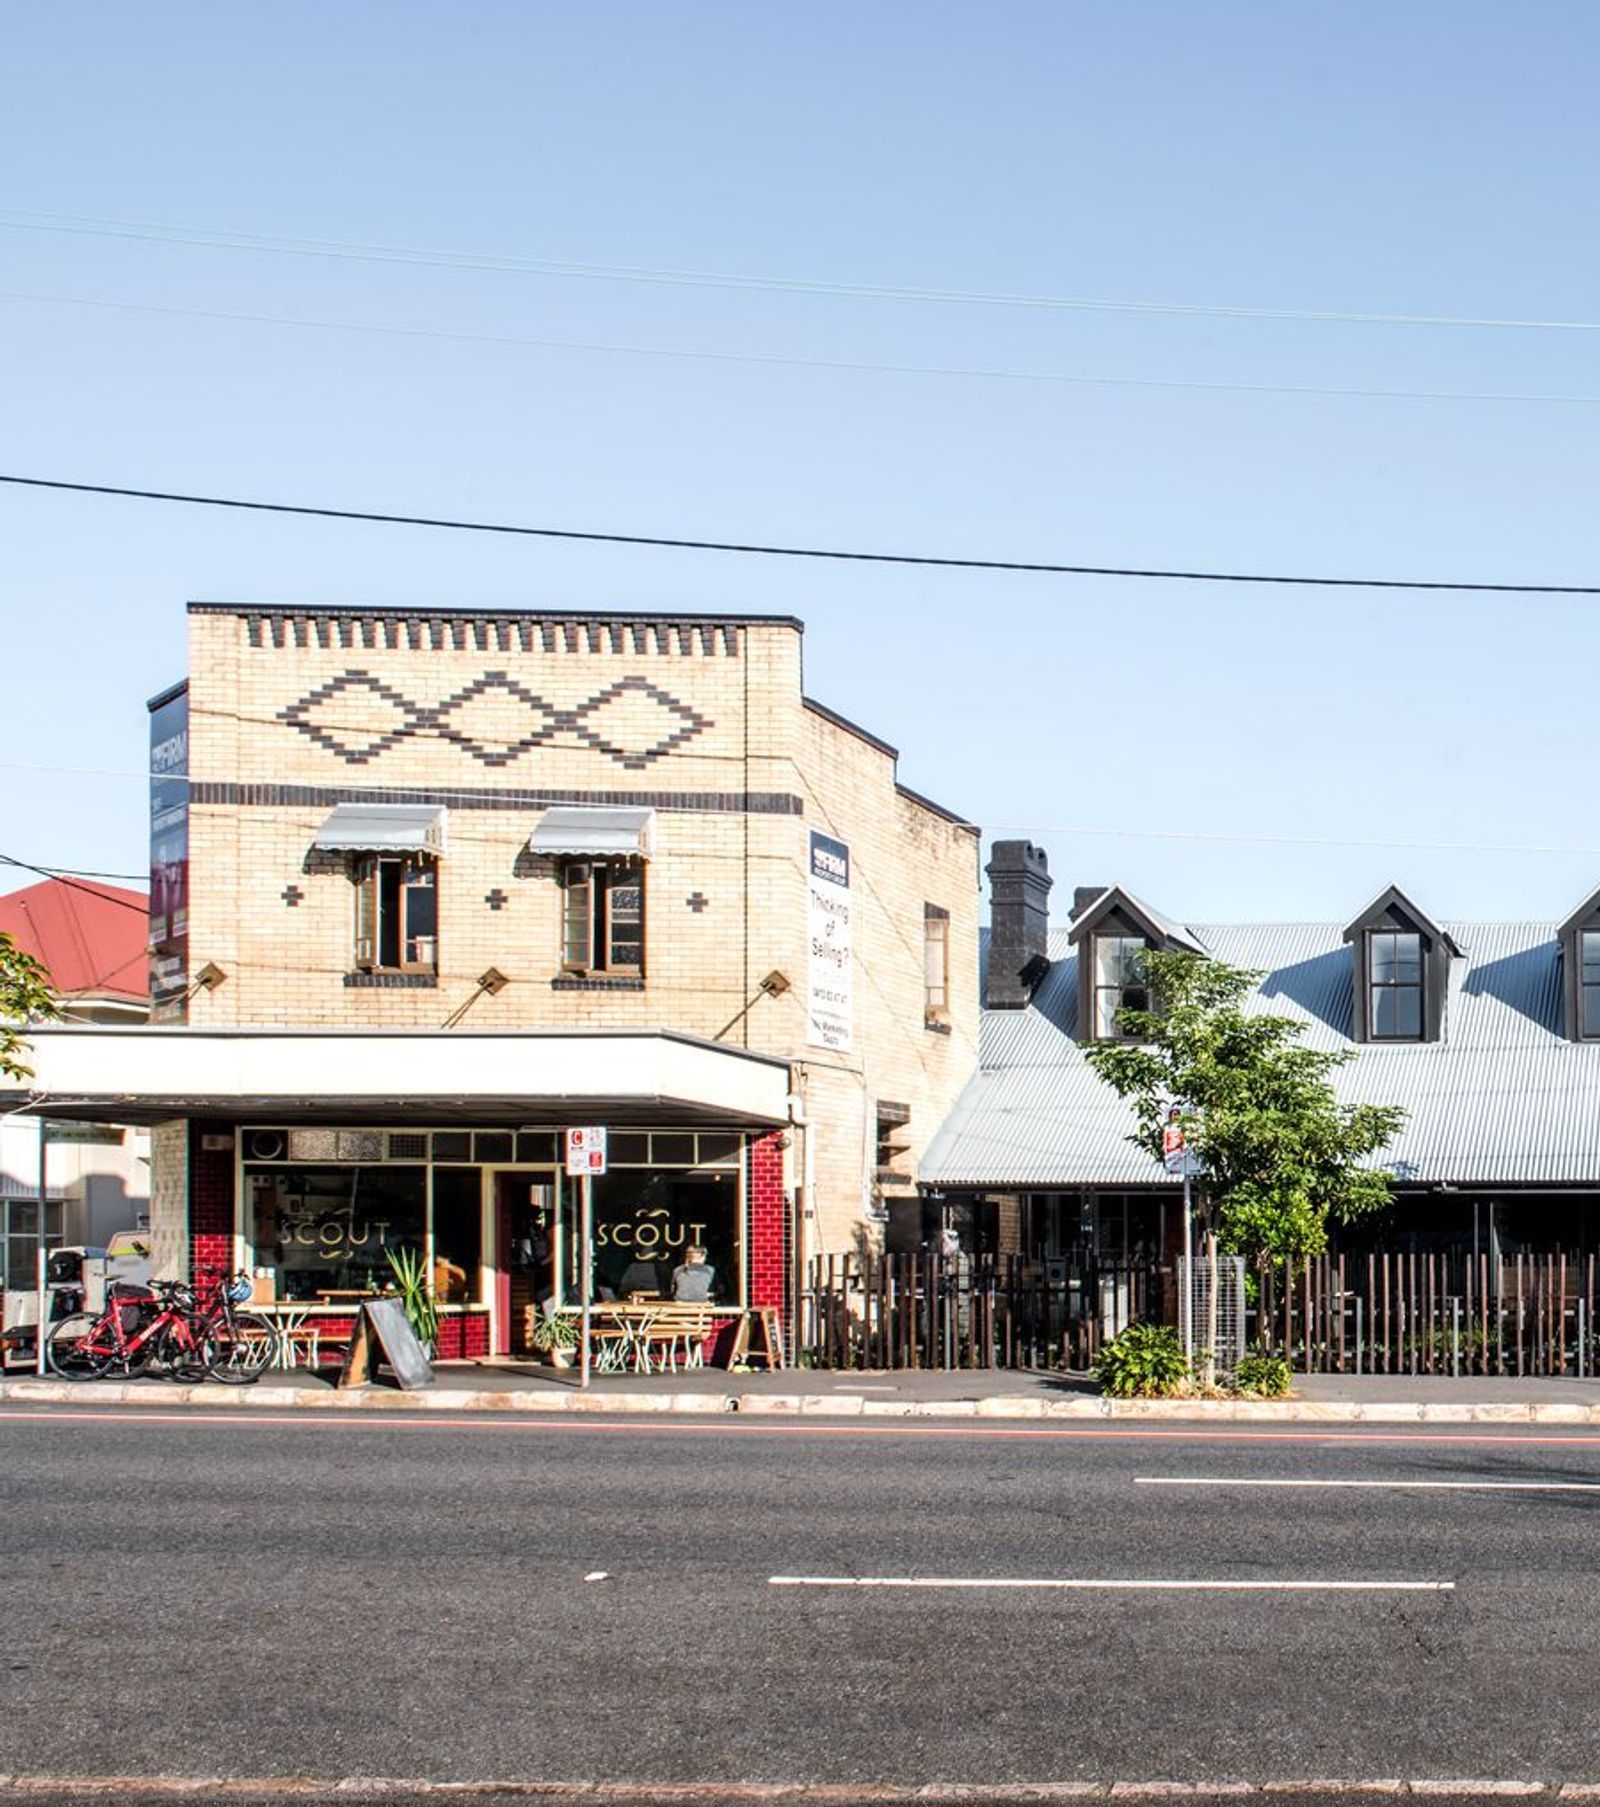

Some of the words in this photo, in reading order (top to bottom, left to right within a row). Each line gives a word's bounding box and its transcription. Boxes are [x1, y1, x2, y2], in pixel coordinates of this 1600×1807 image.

[810, 888, 849, 925] Thinking
[812, 936, 850, 968] Selling?
[280, 1221, 391, 1246] SCOUT
[597, 1222, 707, 1246] SCOUT
